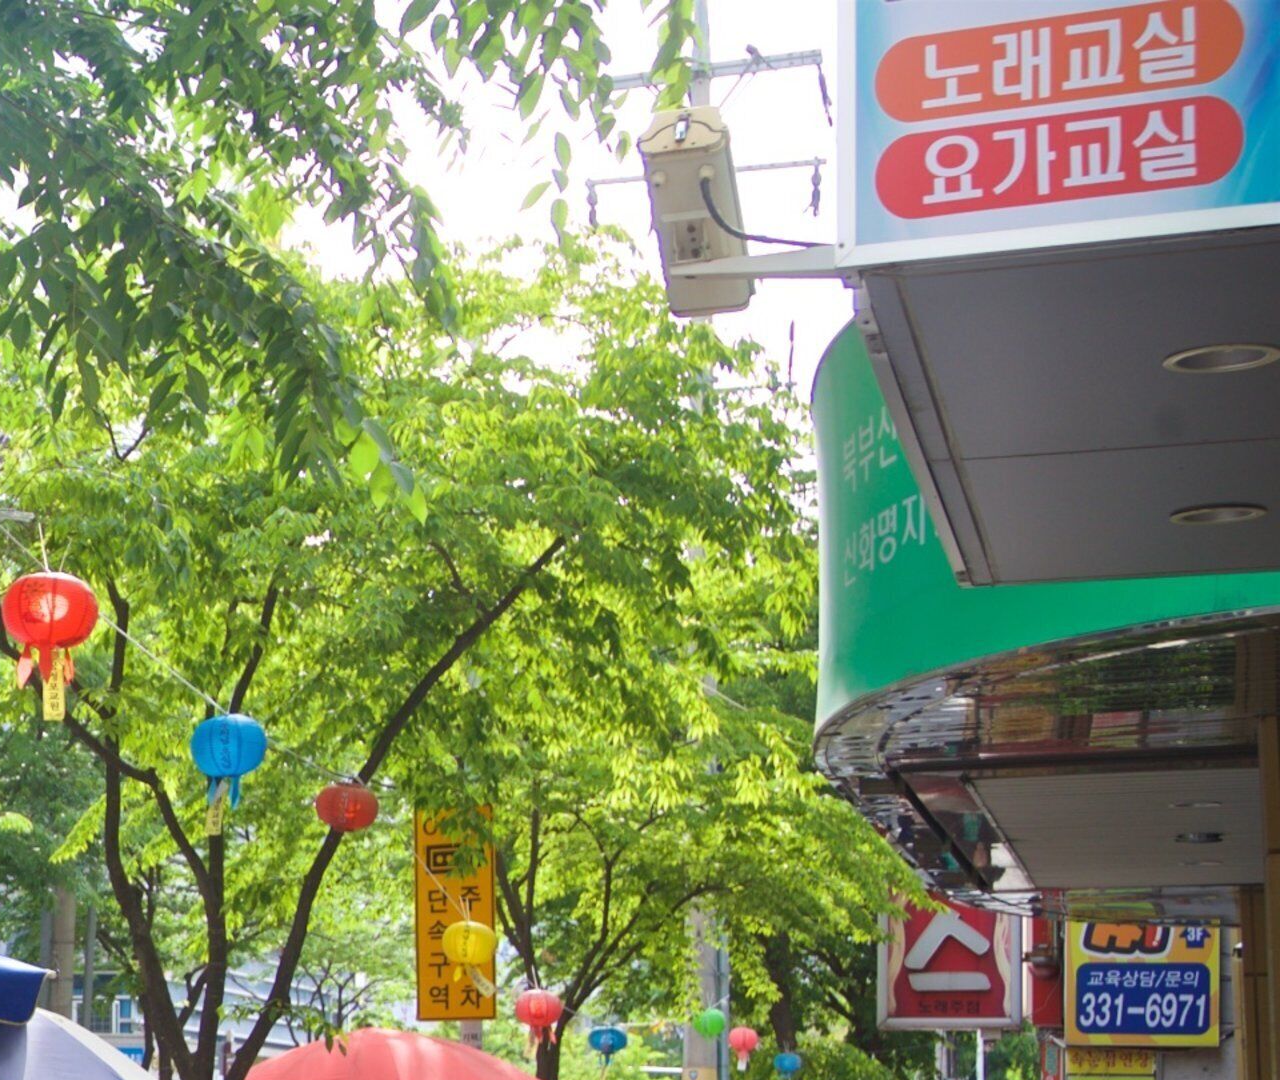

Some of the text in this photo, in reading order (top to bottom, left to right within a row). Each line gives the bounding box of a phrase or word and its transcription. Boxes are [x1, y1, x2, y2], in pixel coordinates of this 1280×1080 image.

[922, 6, 1197, 109] 노래교실
[922, 105, 1198, 205] 요가교실
[844, 493, 939, 588] 신화명지
[903, 908, 992, 993] 스
[1087, 969, 1200, 988] 교육상담/문의
[1079, 992, 1207, 1029] 331-6971
